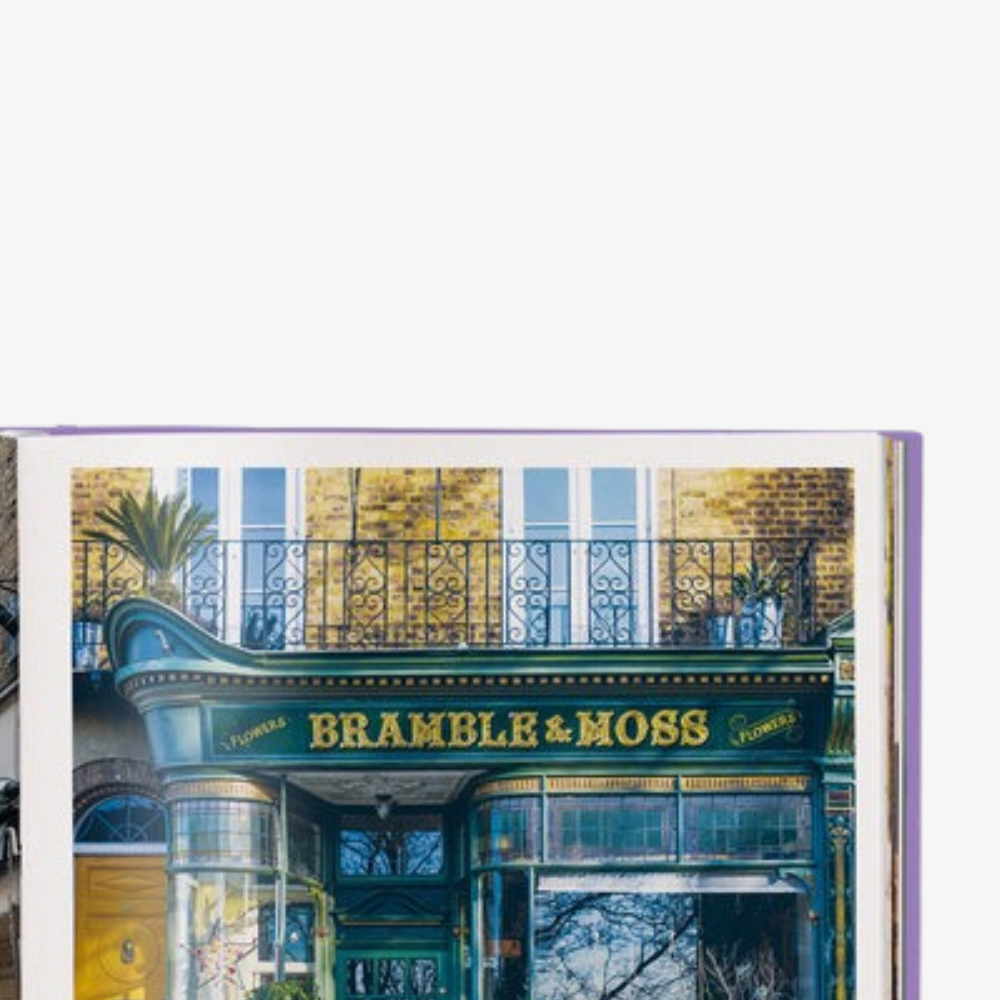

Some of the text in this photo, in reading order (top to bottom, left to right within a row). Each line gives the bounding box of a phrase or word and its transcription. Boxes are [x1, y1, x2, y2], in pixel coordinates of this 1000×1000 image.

[230, 716, 287, 748] FLOWERS
[309, 709, 710, 749] BRAMBLE & MOSS
[739, 711, 797, 744] FLOWERS
